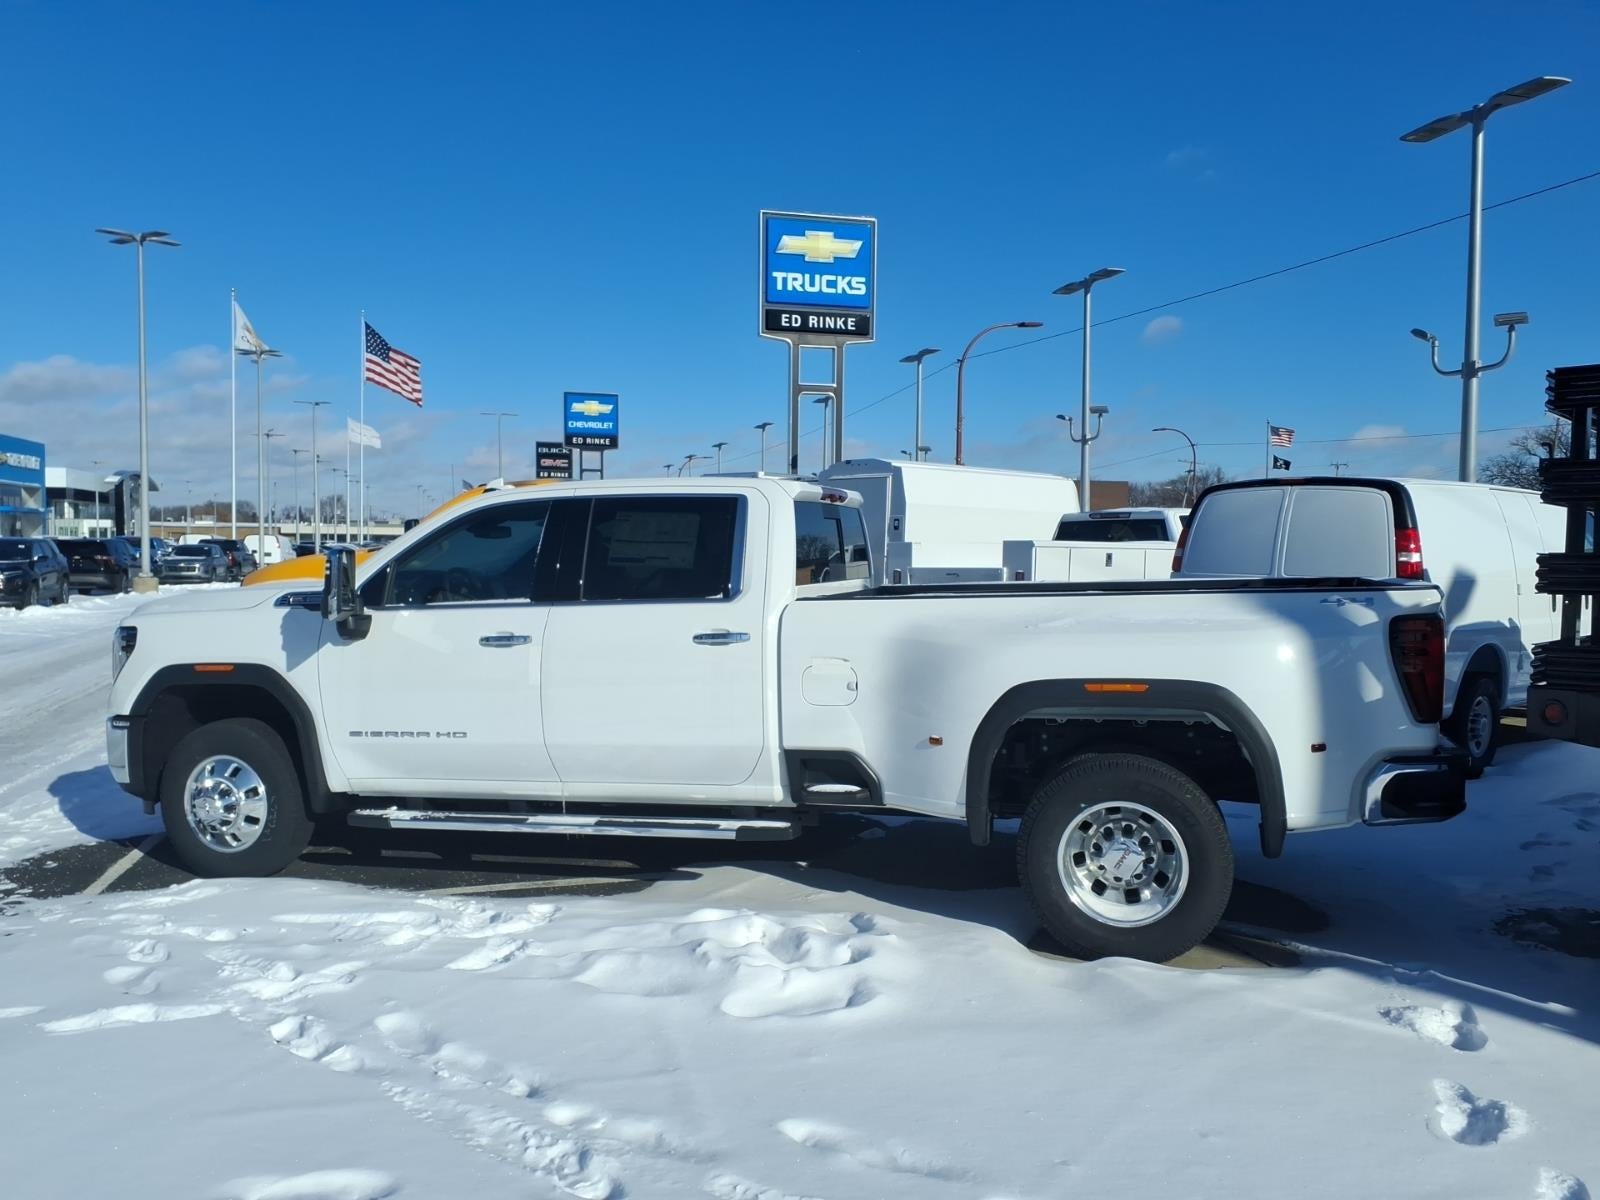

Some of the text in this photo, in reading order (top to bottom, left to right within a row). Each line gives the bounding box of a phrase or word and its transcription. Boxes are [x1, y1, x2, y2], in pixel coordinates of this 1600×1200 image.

[772, 271, 867, 295] TRUCKS
[781, 314, 856, 330] ED RINKE
[568, 420, 613, 429] CHEVROLET
[572, 436, 611, 445] ED RINKE
[540, 459, 568, 467] GMC
